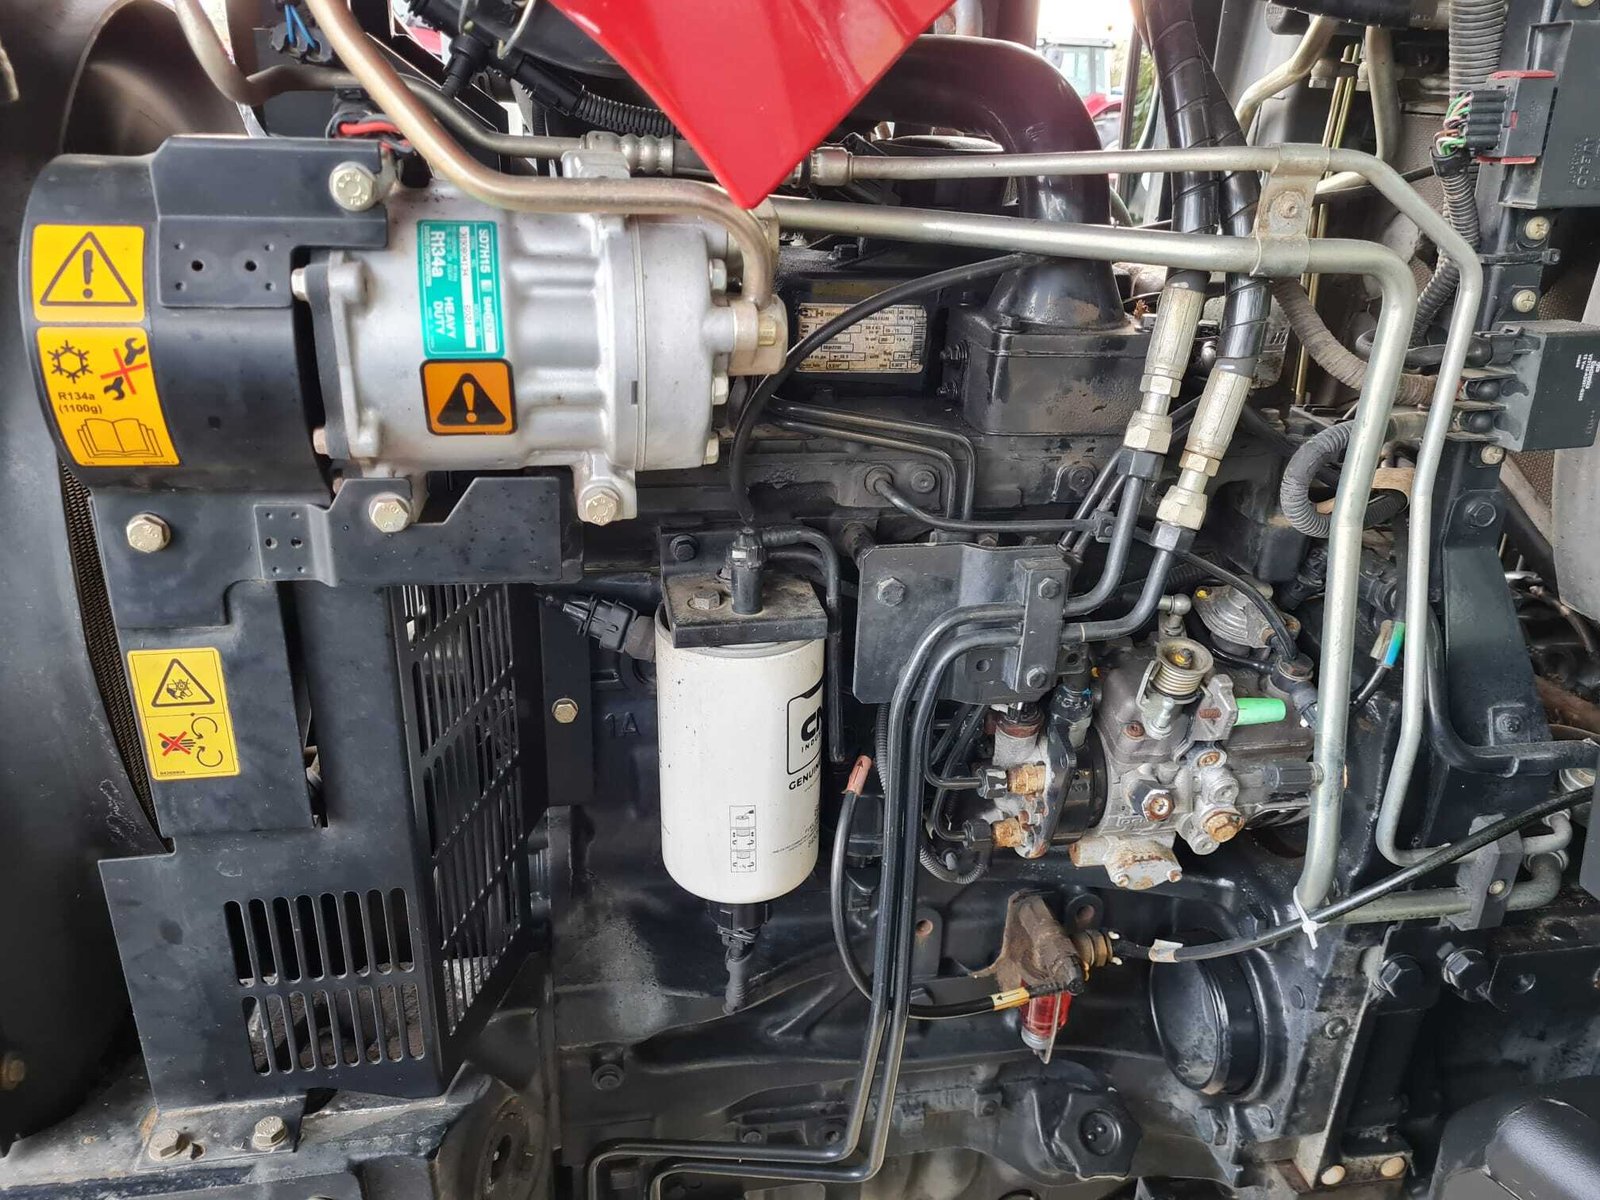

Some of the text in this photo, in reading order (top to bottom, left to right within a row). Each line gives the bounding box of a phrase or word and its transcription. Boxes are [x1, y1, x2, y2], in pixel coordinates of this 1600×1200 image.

[430, 231, 446, 278] R134a
[478, 228, 491, 273] SD7H15
[433, 301, 445, 335] DUTY
[444, 296, 456, 339] HEAVY
[58, 392, 95, 401] R134a
[58, 404, 102, 414] (1100g)
